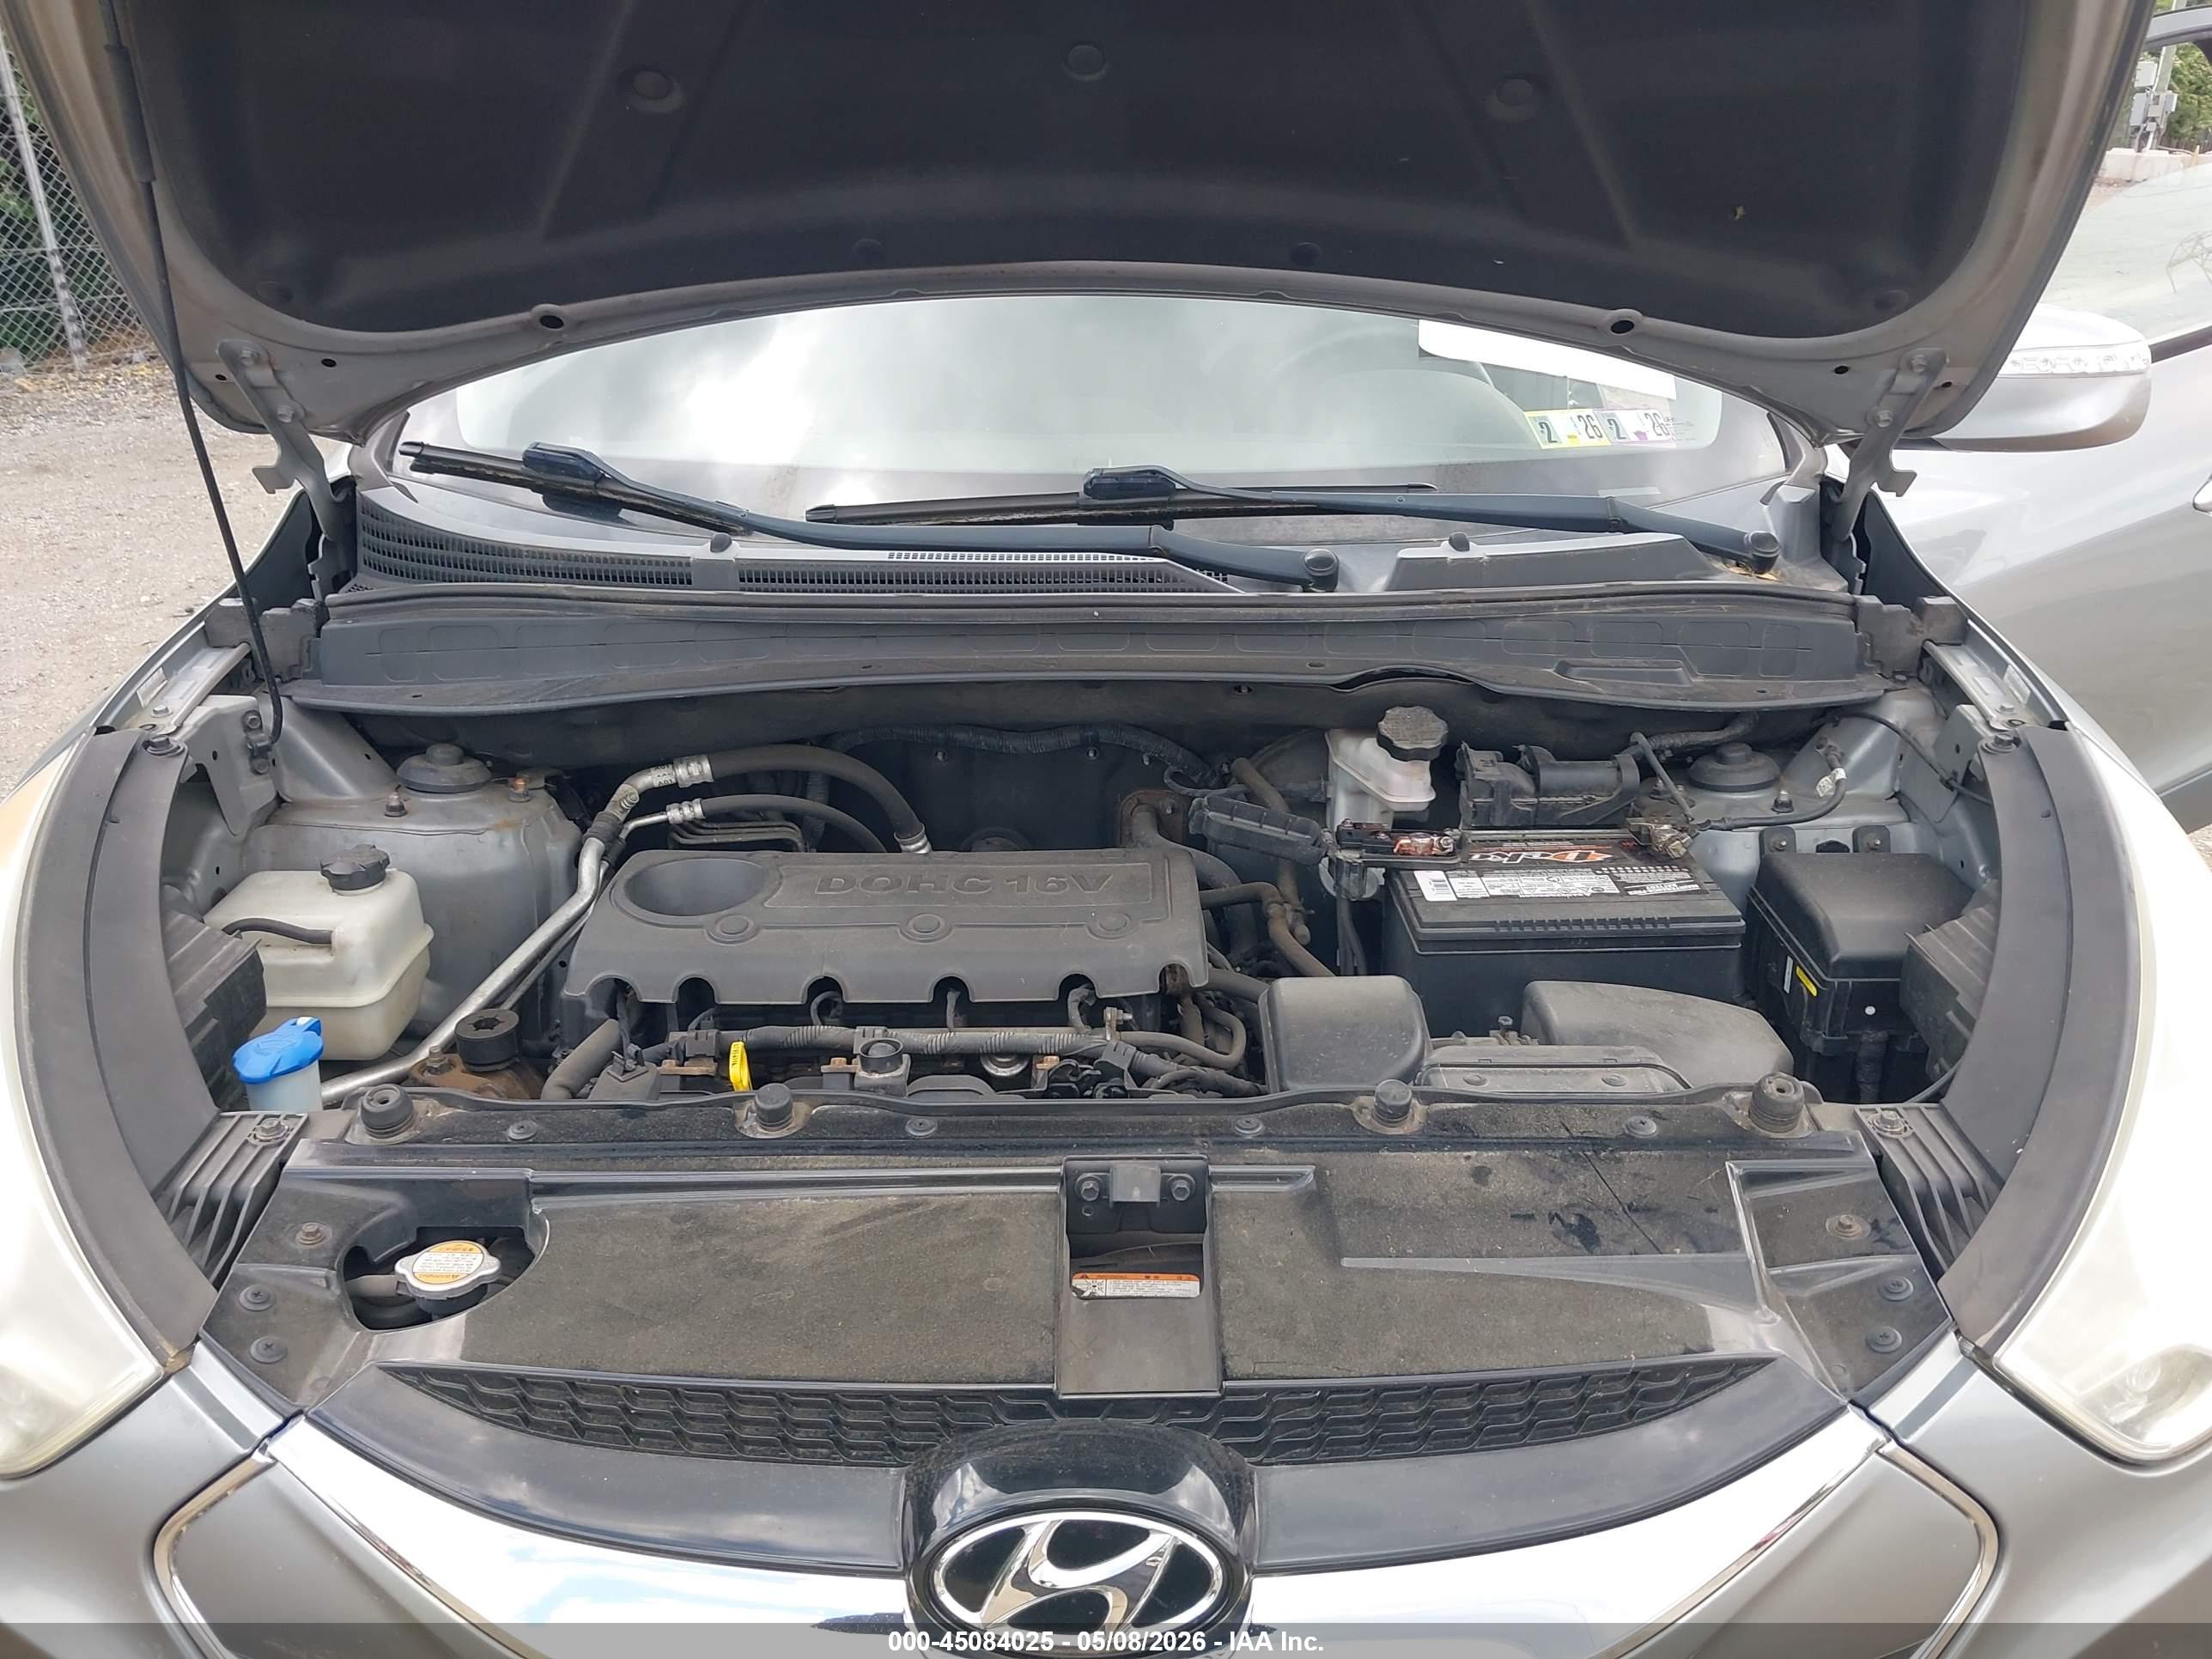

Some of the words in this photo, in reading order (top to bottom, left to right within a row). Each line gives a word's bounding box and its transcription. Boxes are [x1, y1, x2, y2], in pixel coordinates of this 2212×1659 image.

[1538, 421, 1559, 444] 2
[1577, 414, 1603, 440] 26
[1607, 417, 1627, 441] 2
[1644, 412, 1670, 436] 26
[658, 778, 673, 787] A01
[815, 873, 993, 895] DOHC
[1004, 872, 1114, 895] 16V
